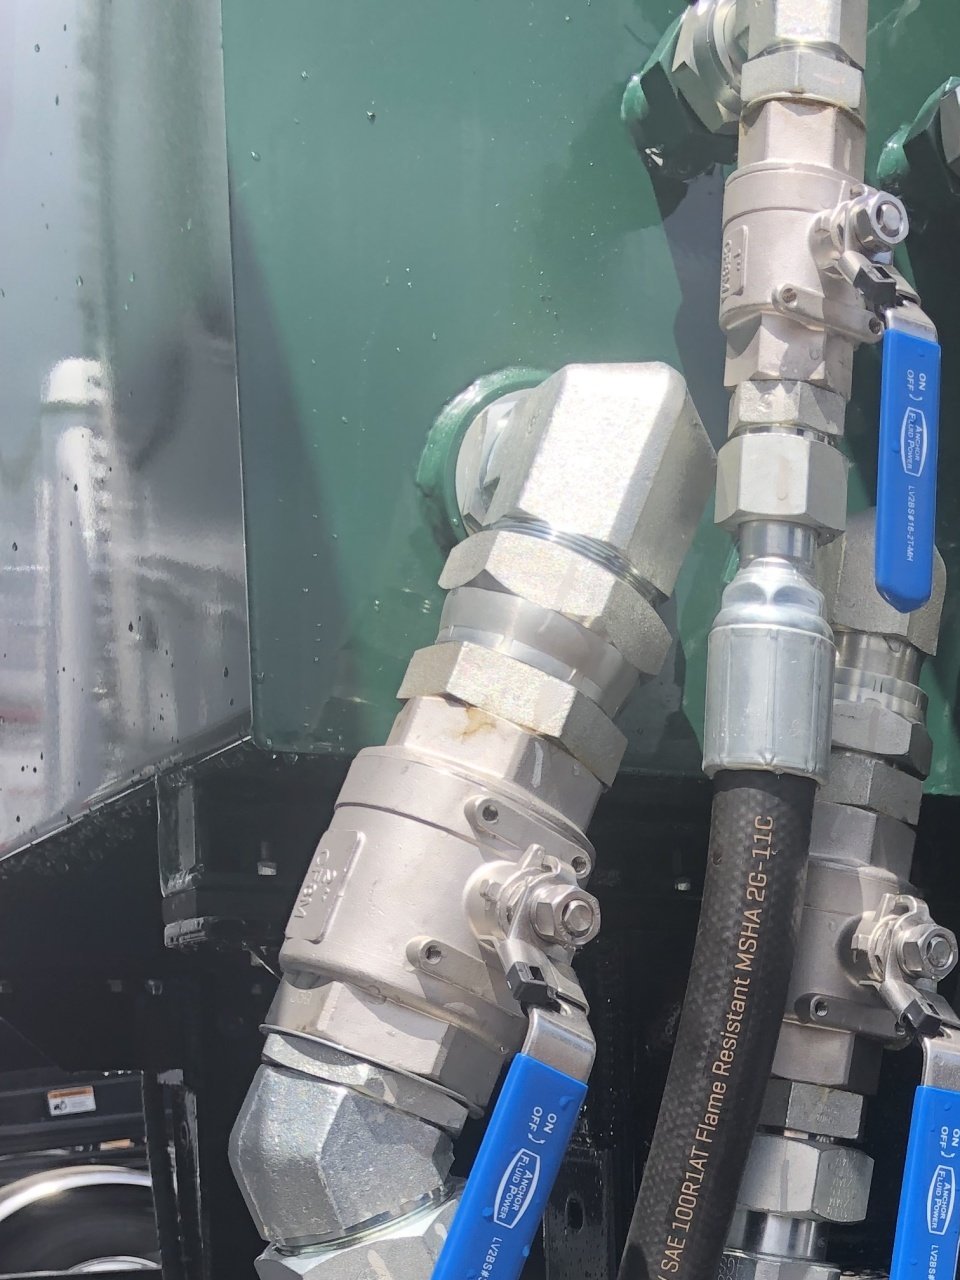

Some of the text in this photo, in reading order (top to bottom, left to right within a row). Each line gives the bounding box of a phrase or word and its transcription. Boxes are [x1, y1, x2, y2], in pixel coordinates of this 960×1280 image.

[906, 369, 914, 391] OFF
[918, 373, 925, 390] ON
[746, 814, 774, 902] 2G-11C
[734, 905, 762, 970] MSHA
[711, 975, 750, 1075] Resistant
[526, 1105, 544, 1131] OFF
[542, 1112, 557, 1133] ON
[695, 1080, 727, 1143] Flame
[939, 1126, 948, 1148] OFF
[951, 1128, 960, 1146] ON
[671, 1145, 710, 1232] 100R1AT
[660, 1234, 686, 1273] SAE
